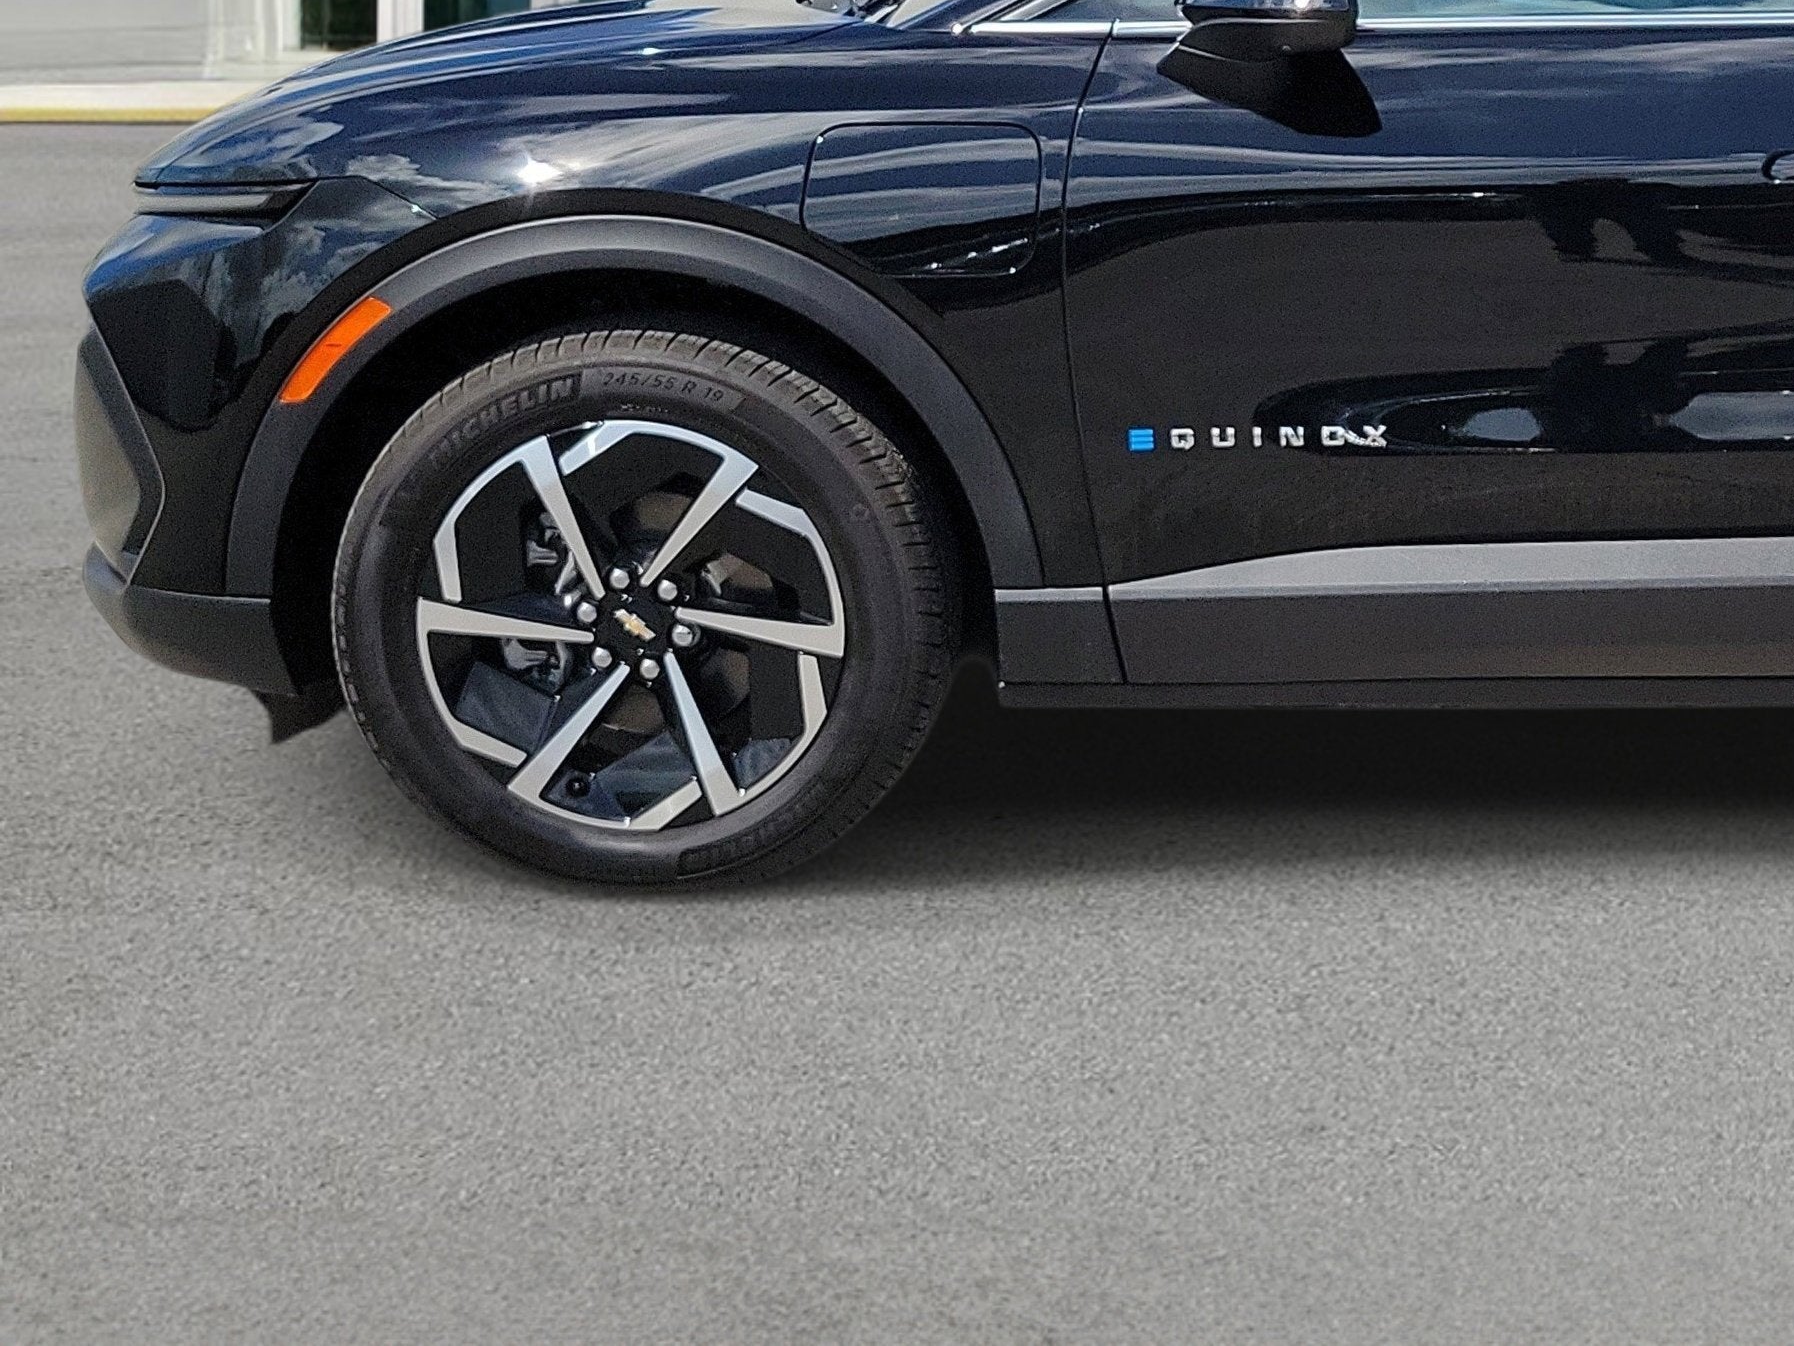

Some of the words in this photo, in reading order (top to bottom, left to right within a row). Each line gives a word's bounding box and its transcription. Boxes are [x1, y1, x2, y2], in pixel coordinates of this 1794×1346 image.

[603, 371, 677, 390] 245/55
[681, 381, 697, 393] R
[703, 386, 724, 402] 19
[424, 377, 573, 471] MICHELIN
[1127, 424, 1387, 451] EQUINOX
